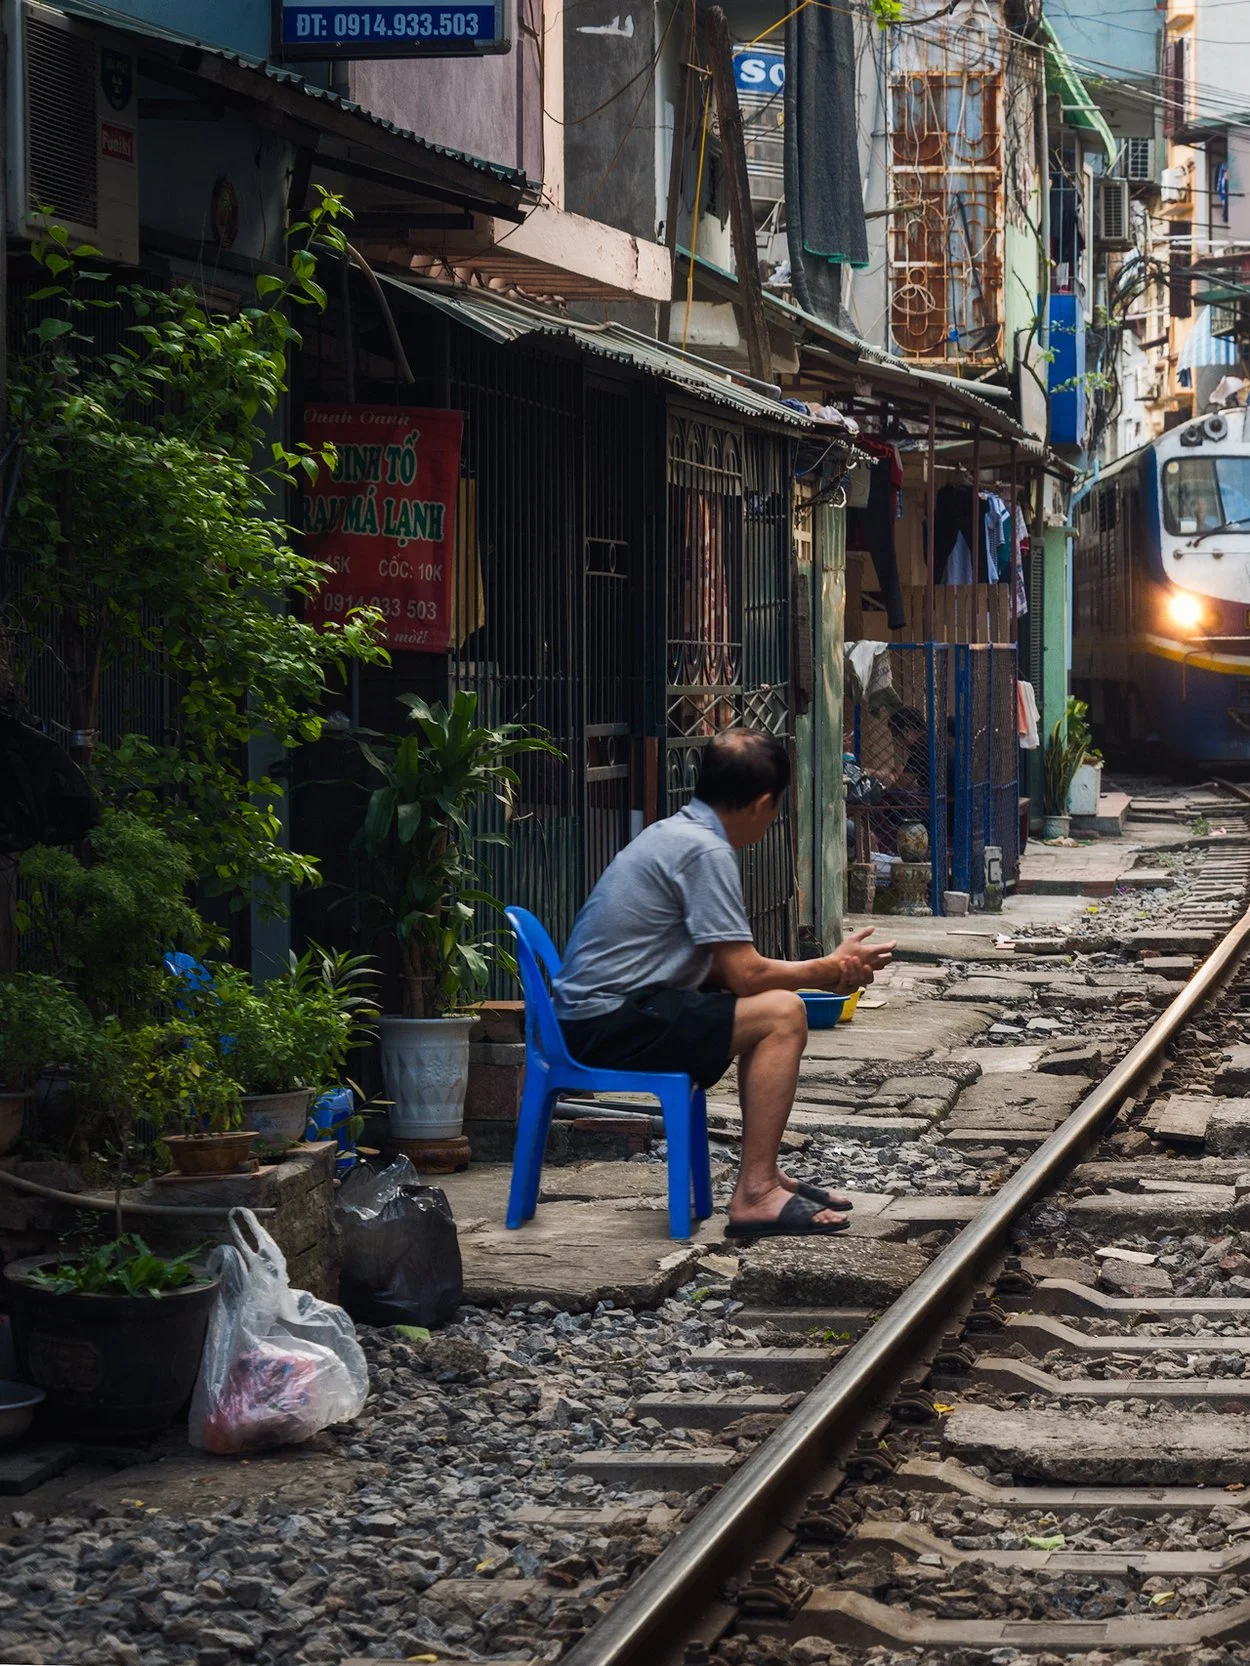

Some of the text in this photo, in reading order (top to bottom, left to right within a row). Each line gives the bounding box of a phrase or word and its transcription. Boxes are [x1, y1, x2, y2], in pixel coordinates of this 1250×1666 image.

[296, 12, 480, 37] ĐT: 0914.933.503
[387, 430, 421, 486] TỐ
[341, 485, 381, 537] MÁ
[381, 496, 446, 547] LẠNH
[378, 551, 413, 580] CỐC:
[417, 562, 443, 583] 10K
[406, 599, 438, 621] 503
